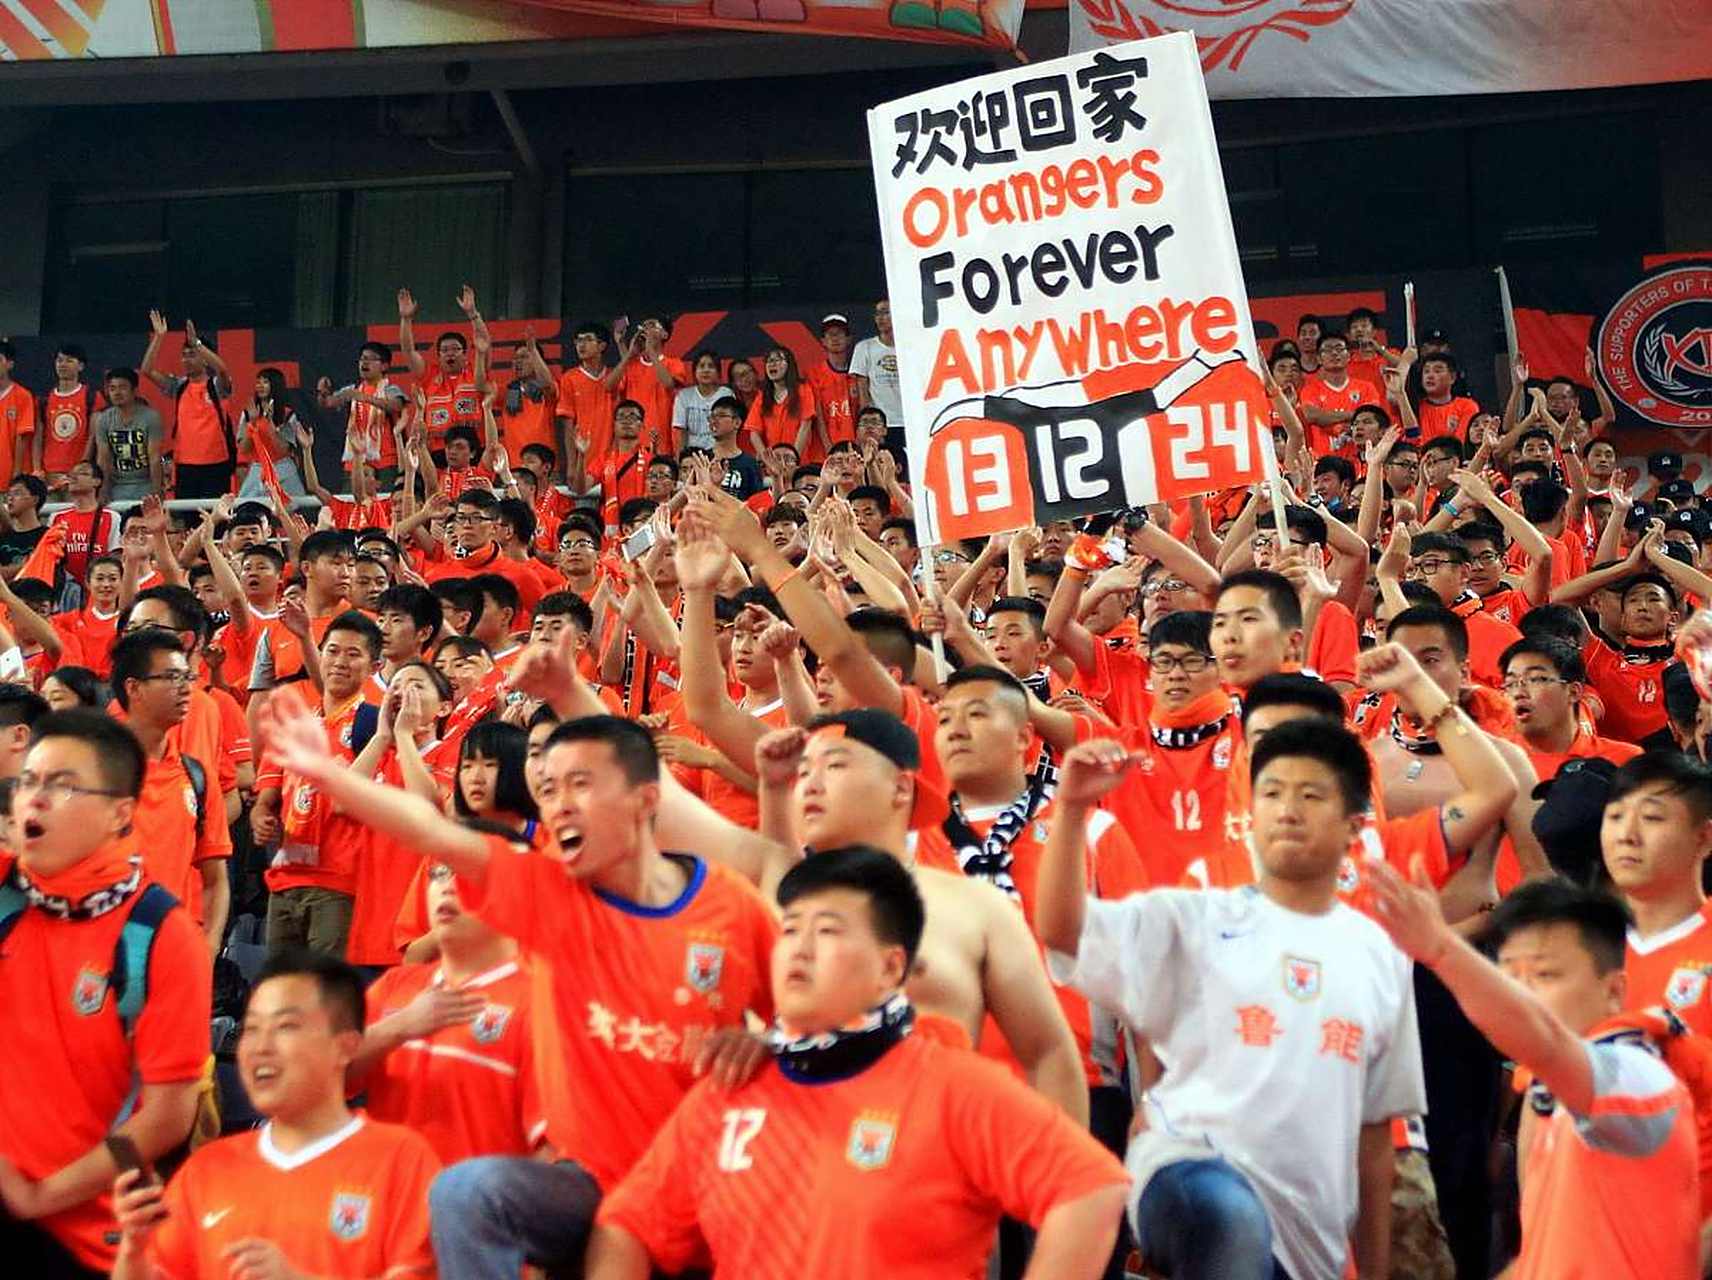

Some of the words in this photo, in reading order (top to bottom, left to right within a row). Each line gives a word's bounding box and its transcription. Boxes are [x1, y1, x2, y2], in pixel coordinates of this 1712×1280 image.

[891, 53, 1149, 179] 欢迎回家
[902, 149, 1164, 248] Orangers
[920, 224, 1174, 328] Forever
[1673, 278, 1695, 293] OF
[1610, 286, 1670, 362] SUPPORTERS
[1611, 367, 1633, 391] THE
[945, 435, 1012, 516] 13
[1035, 419, 1109, 503] 12
[1164, 400, 1252, 480] 24
[1171, 789, 1202, 831] 12
[719, 1108, 767, 1171] 12
